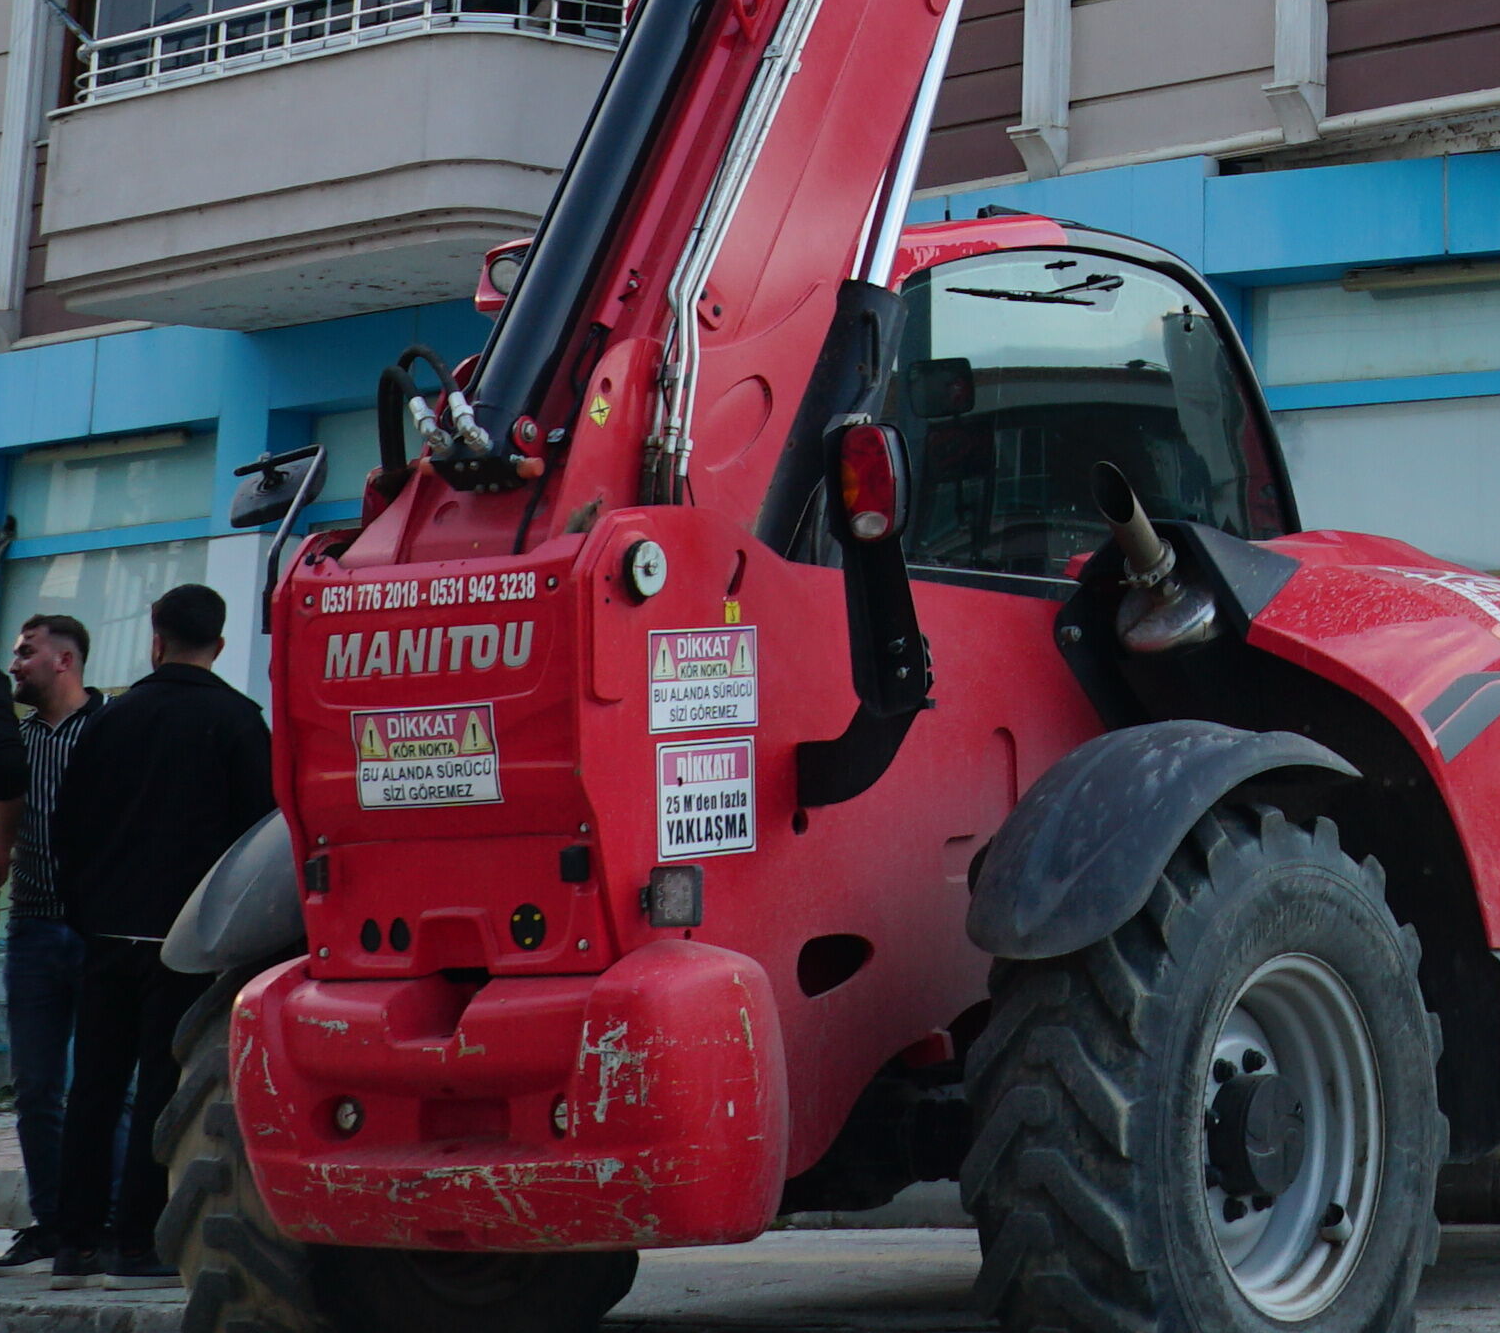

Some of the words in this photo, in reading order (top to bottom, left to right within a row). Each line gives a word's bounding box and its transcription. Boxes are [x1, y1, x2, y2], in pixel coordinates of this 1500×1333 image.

[321, 586, 353, 613] 0531
[357, 583, 382, 610] 776
[384, 581, 418, 609] 2018
[430, 577, 463, 605] 0531
[468, 575, 495, 603] 942
[499, 571, 536, 600] 3238
[324, 620, 535, 679] MANITOU
[677, 633, 731, 659] DİKKAT
[680, 663, 699, 678] KÖR
[701, 663, 728, 677] NOKTA
[654, 689, 668, 702] BU
[670, 686, 711, 701] ALANDA
[713, 680, 753, 699] SÜRÜCÜ
[670, 705, 688, 722] SİZİ
[690, 704, 738, 721] GÖREMEZ
[387, 713, 457, 739] DİKKAT
[393, 743, 415, 759] KÖR
[418, 741, 456, 757] NOKTA
[362, 768, 379, 782] BU
[382, 765, 434, 781] ALANDA
[437, 758, 492, 779] SÜRÜCÜ
[676, 752, 736, 784] DİKKAT!
[383, 785, 406, 801] SİZİ
[409, 783, 474, 800] GÖREMEZ
[666, 795, 680, 814] 25
[684, 794, 717, 812] M'den
[720, 790, 747, 808] fazla
[666, 813, 748, 846] YAKLAŞMA
